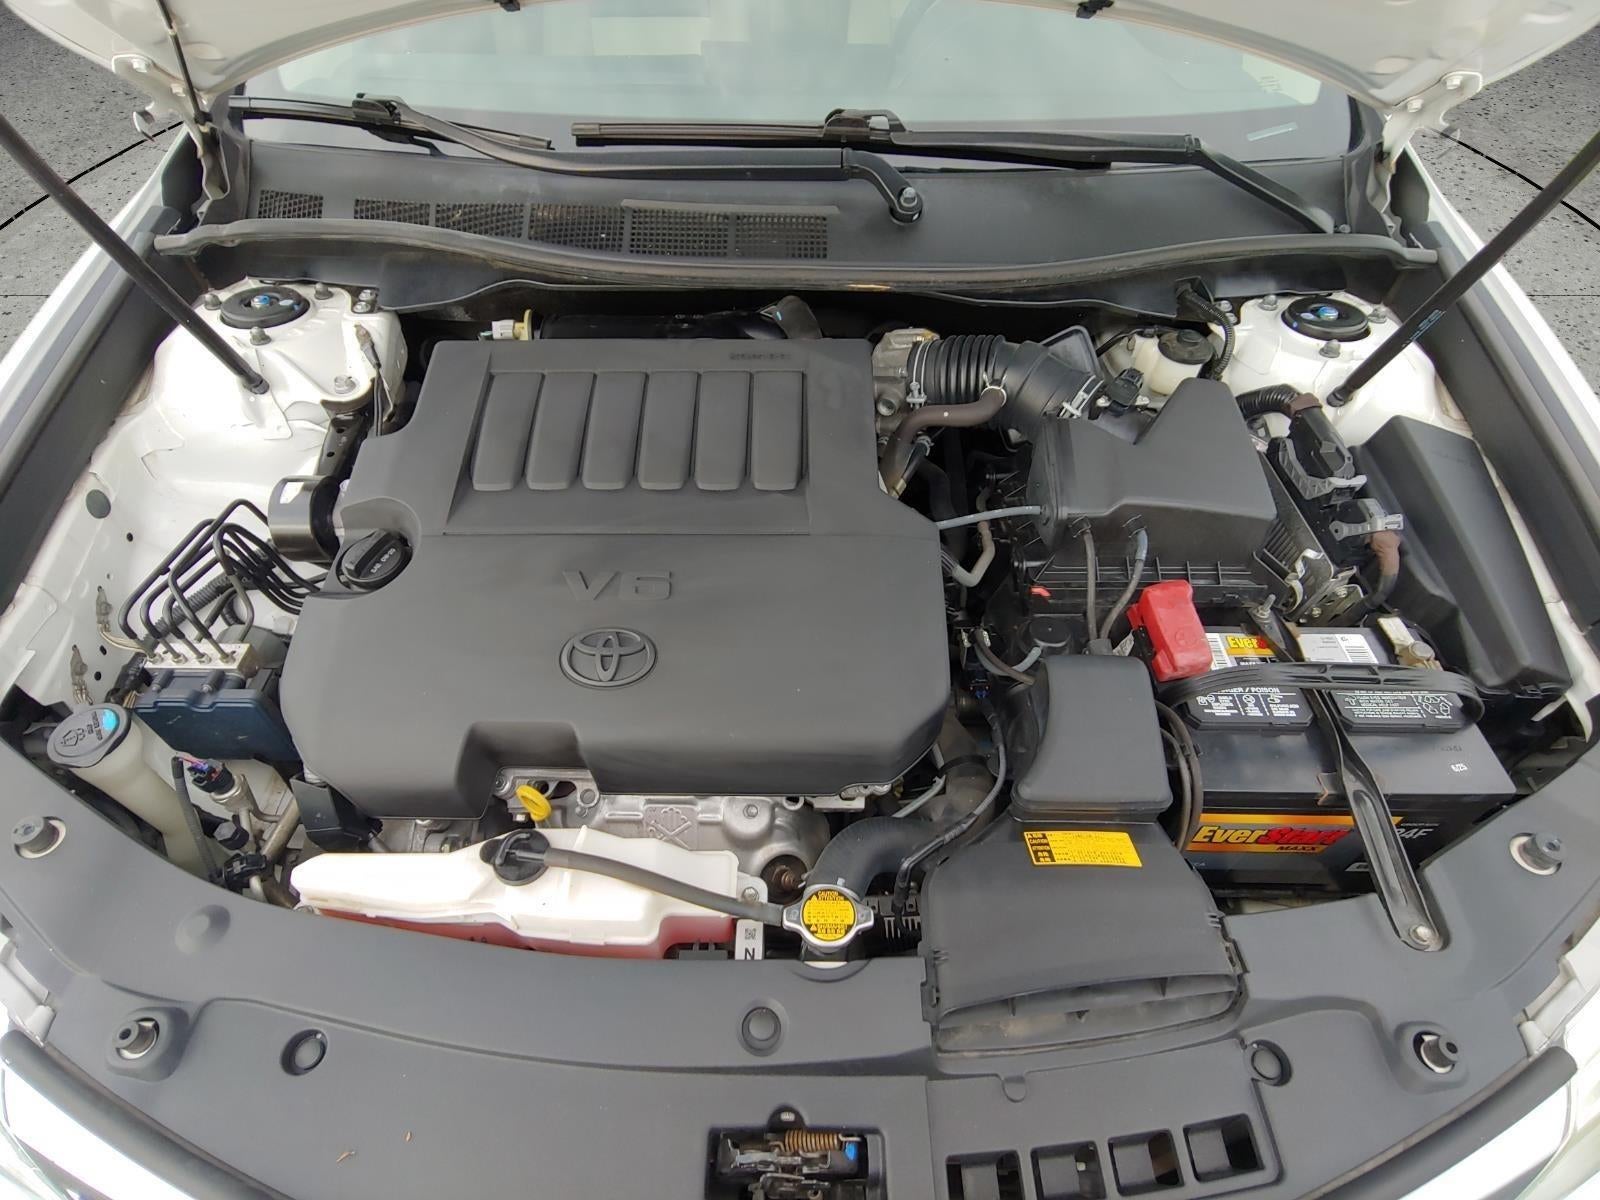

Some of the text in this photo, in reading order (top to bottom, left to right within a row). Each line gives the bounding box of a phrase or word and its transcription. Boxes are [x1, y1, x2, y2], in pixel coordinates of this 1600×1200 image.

[562, 570, 673, 601] V6
[1191, 825, 1352, 846] EverStart
[744, 947, 755, 960] N
